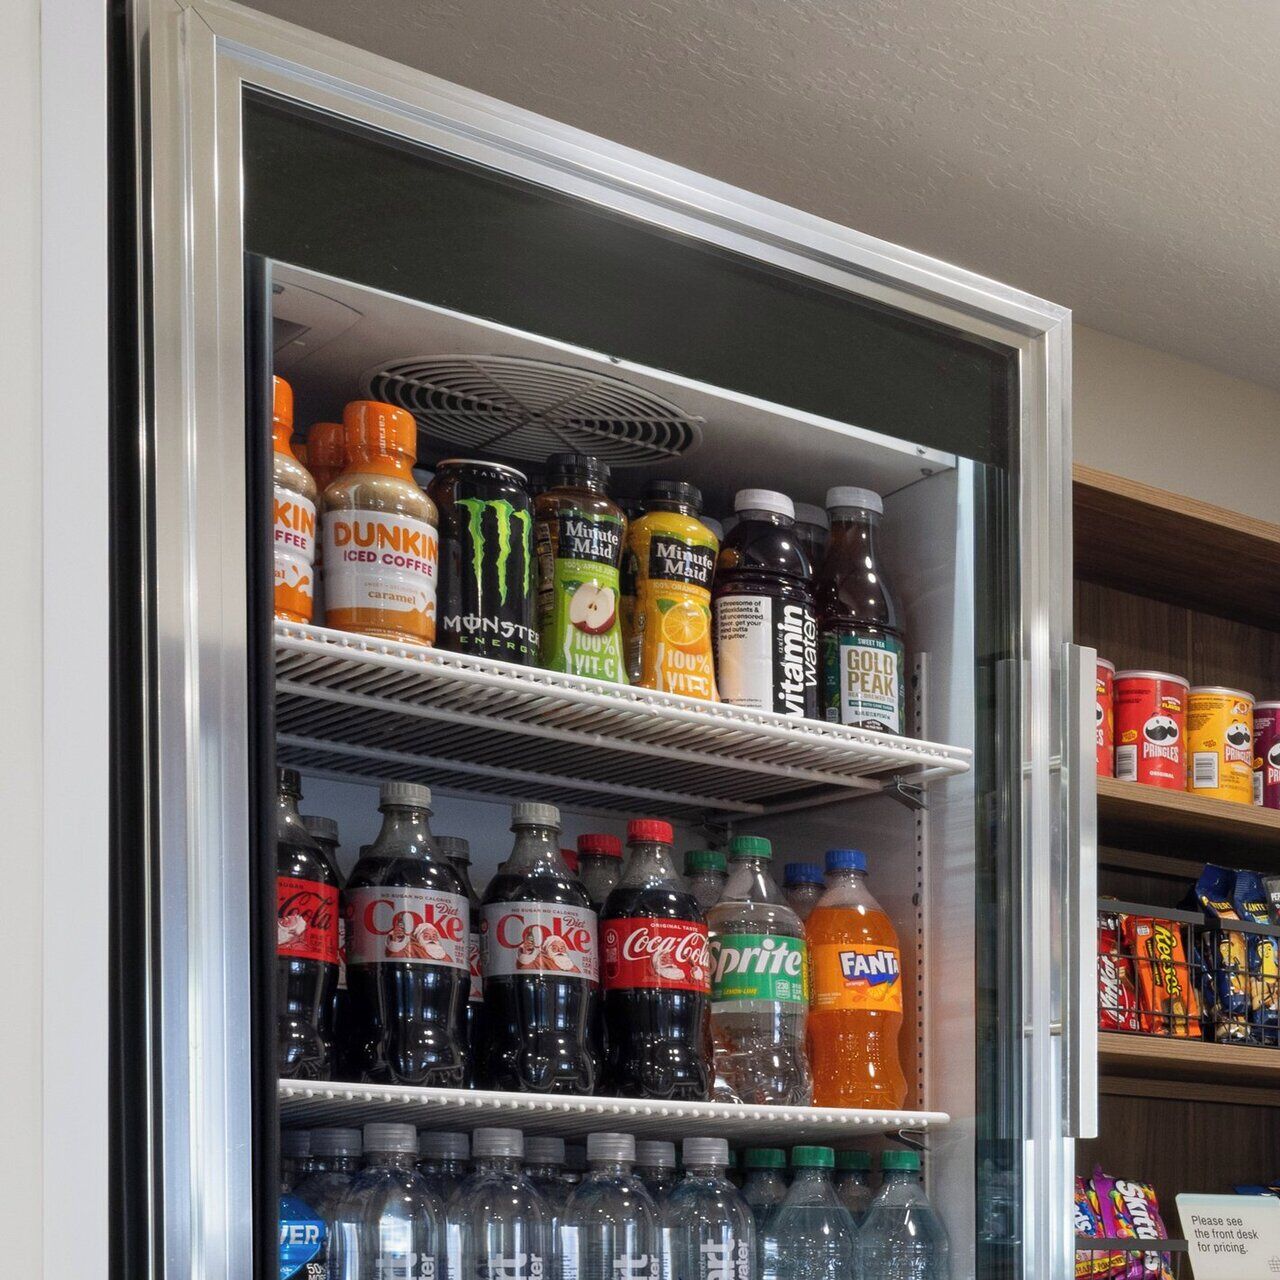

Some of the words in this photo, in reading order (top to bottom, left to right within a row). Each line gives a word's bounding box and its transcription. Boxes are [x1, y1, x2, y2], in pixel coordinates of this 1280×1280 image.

[333, 522, 439, 564] DUNKIN
[566, 521, 619, 545] Minute
[574, 539, 613, 559] Maid
[656, 543, 713, 569] Minute
[344, 551, 376, 563] ICED
[382, 555, 433, 576] COFFEE
[665, 558, 706, 582] Maid
[368, 590, 416, 605] caramel
[847, 649, 893, 676] GOLD
[847, 673, 894, 697] PEAK
[1143, 741, 1179, 764] PRINGLES
[1149, 770, 1175, 779] ORIGINAL
[363, 900, 464, 942] Coke
[435, 903, 459, 916] Diet
[496, 914, 591, 954] Coke
[563, 915, 585, 929] Diet
[623, 928, 710, 967] Coca-Cola
[709, 938, 802, 982] Sprite
[1154, 925, 1182, 996] Reese's
[1191, 1215, 1224, 1226] Please
[1227, 1217, 1243, 1226] see
[1194, 1229, 1210, 1239] the
[1212, 1230, 1234, 1239] front
[1236, 1230, 1259, 1240] desk
[1197, 1242, 1211, 1252] for
[1214, 1243, 1248, 1254] pricing.
